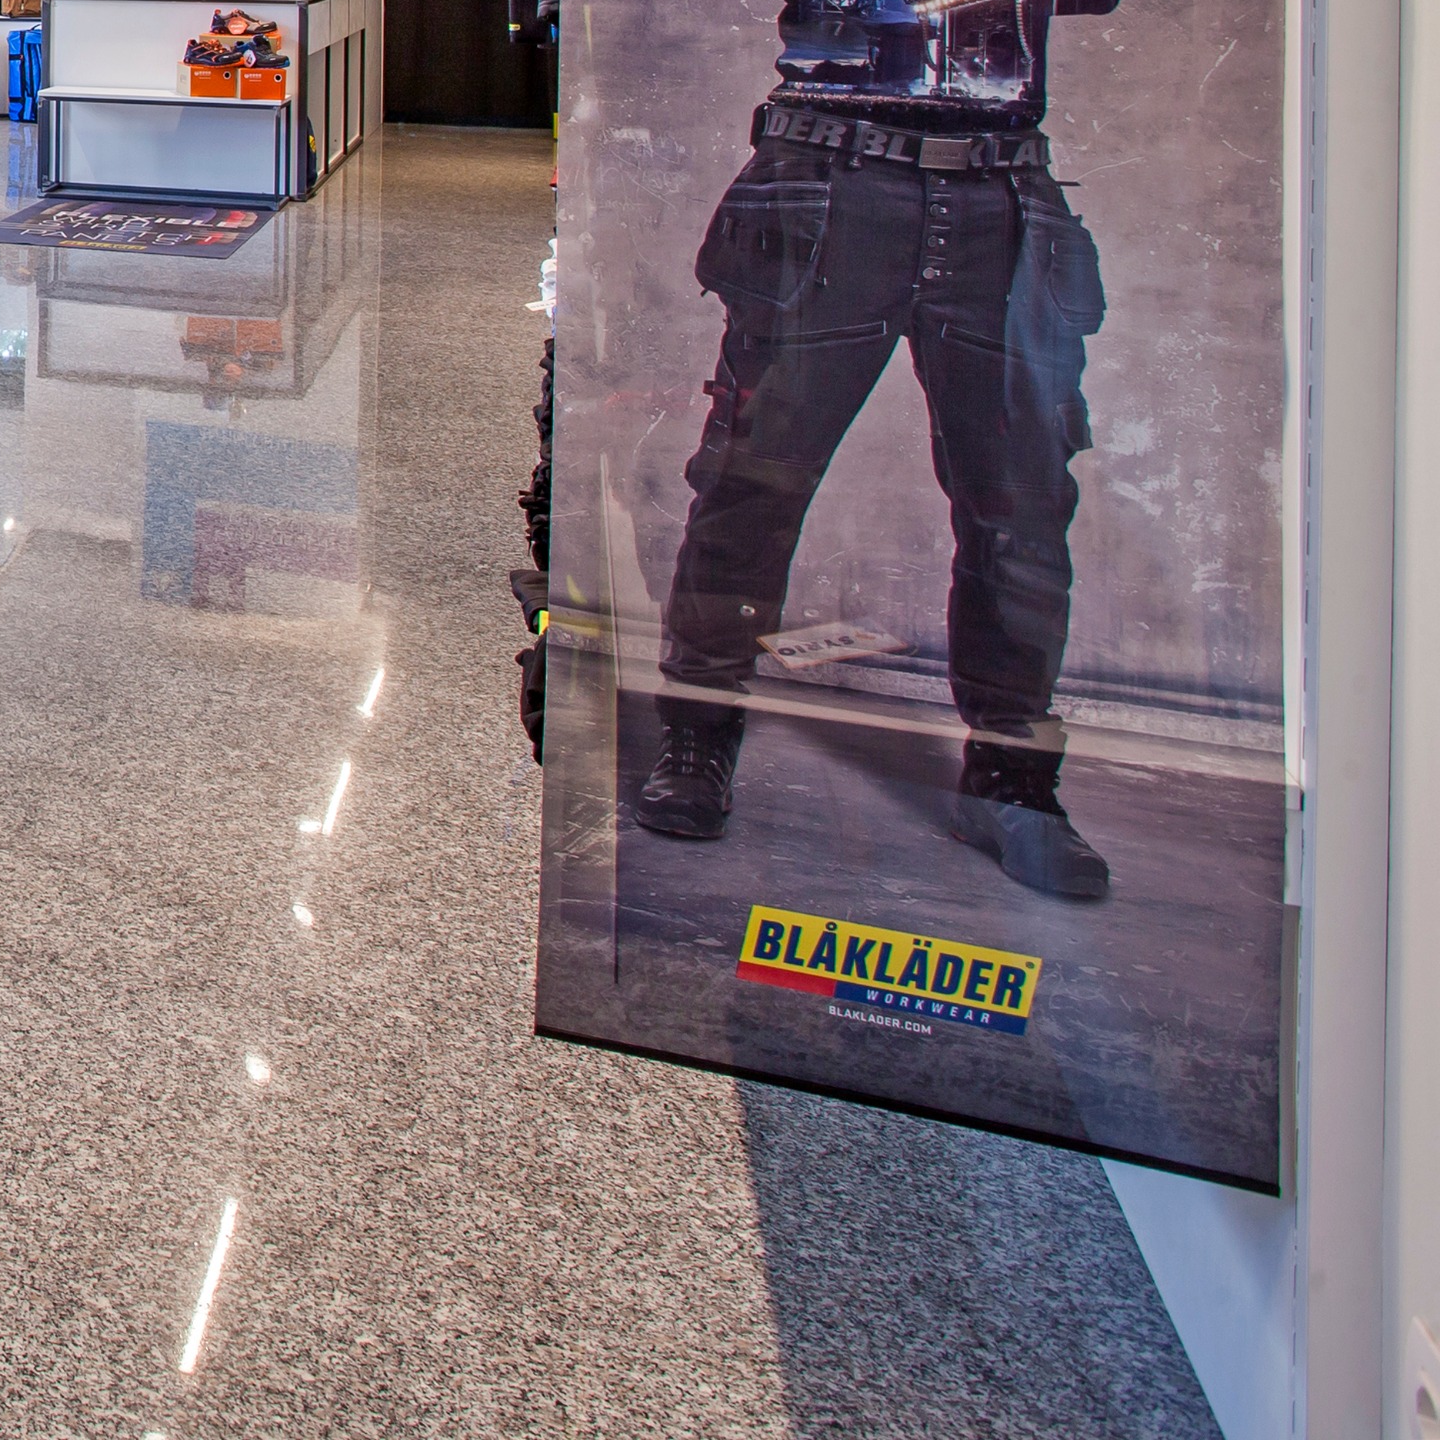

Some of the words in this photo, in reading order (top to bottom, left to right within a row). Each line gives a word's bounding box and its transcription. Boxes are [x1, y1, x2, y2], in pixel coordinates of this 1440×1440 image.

[753, 918, 1029, 1009] BLÅKLÄDER
[829, 1005, 932, 1035] BLAKLADER.COM
[866, 989, 992, 1025] WORKWEAR
